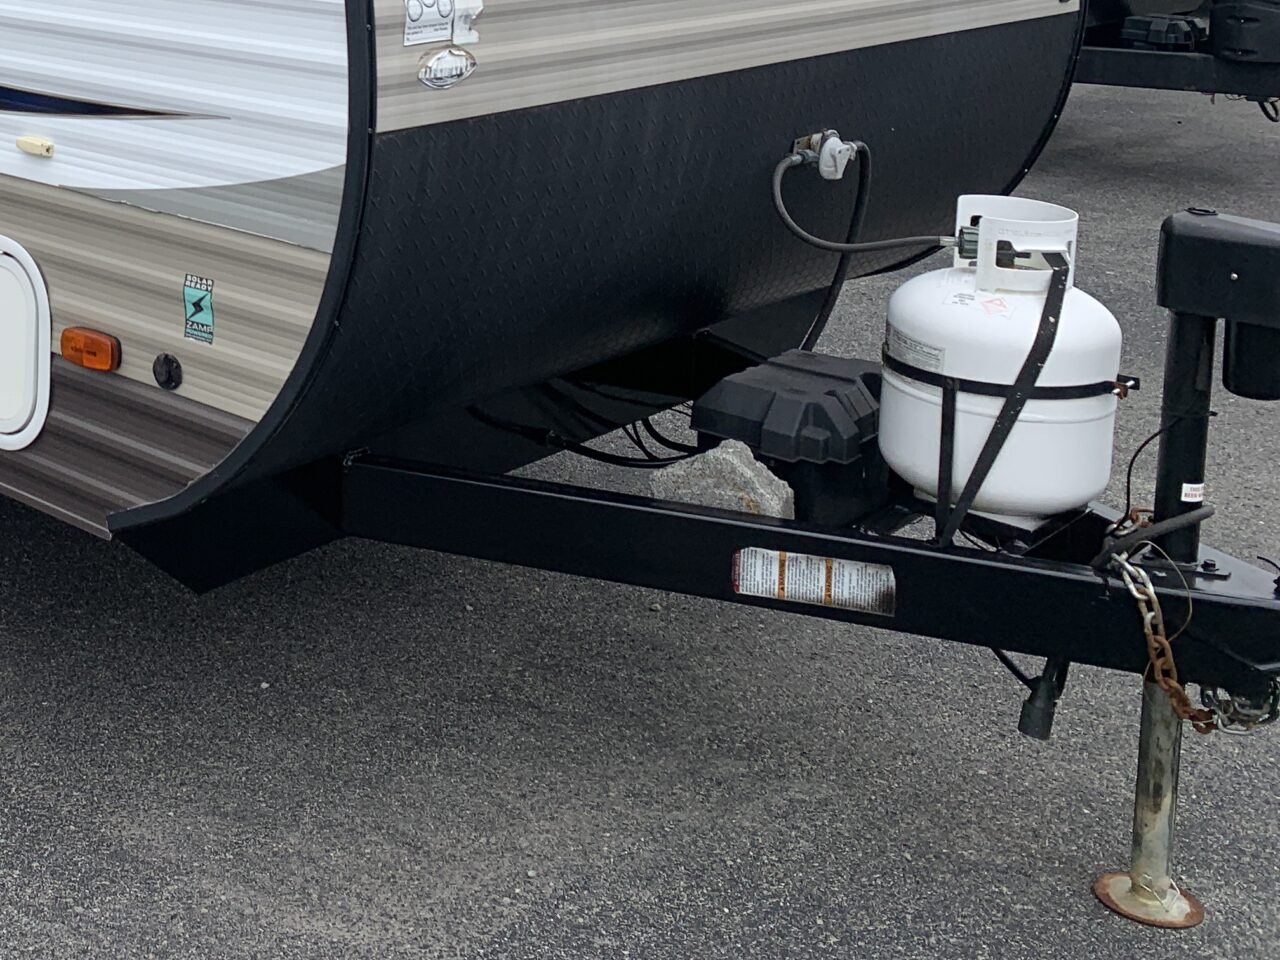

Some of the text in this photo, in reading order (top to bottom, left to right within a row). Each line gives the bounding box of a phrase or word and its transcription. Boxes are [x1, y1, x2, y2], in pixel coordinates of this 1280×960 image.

[186, 275, 213, 286] SOLAR
[185, 281, 213, 292] READY
[186, 320, 213, 332] ZAMP
